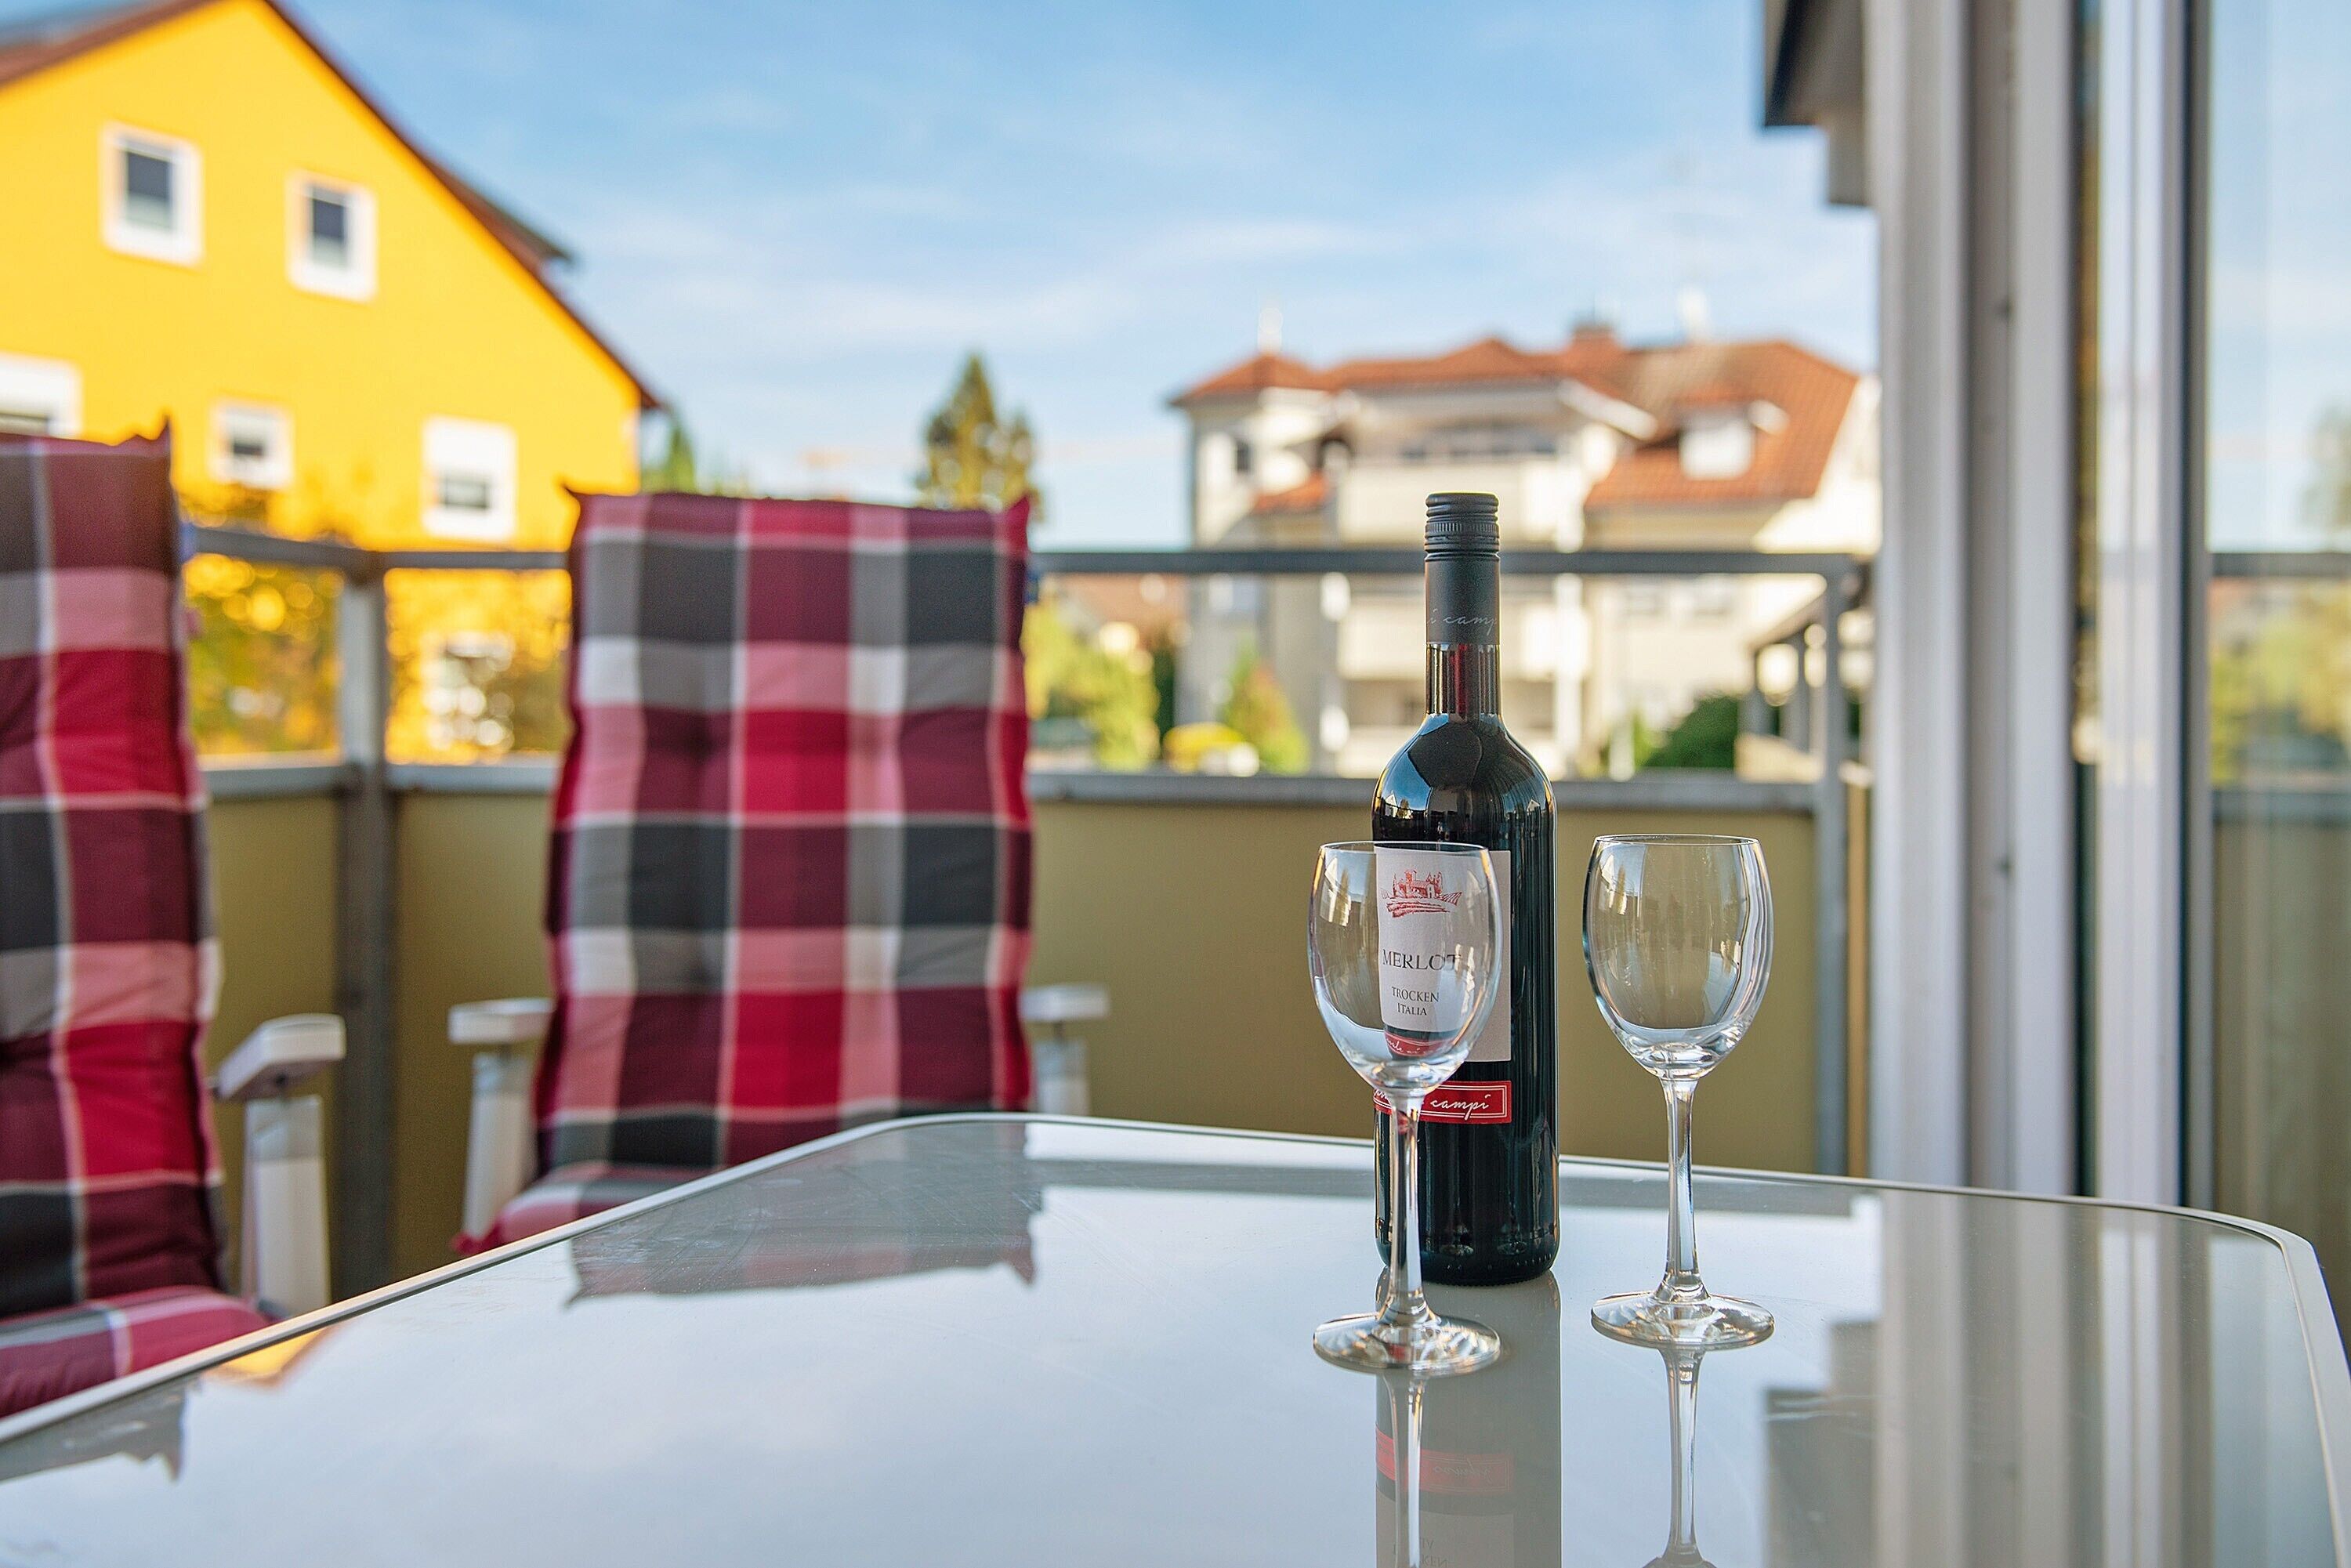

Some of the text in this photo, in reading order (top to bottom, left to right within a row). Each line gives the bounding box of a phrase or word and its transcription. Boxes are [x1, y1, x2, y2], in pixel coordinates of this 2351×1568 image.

[1382, 948, 1462, 971] MERLOT
[1391, 986, 1440, 1002] TROCKEN
[1397, 1002, 1427, 1016] ITALIA
[1430, 1094, 1491, 1121] campi
